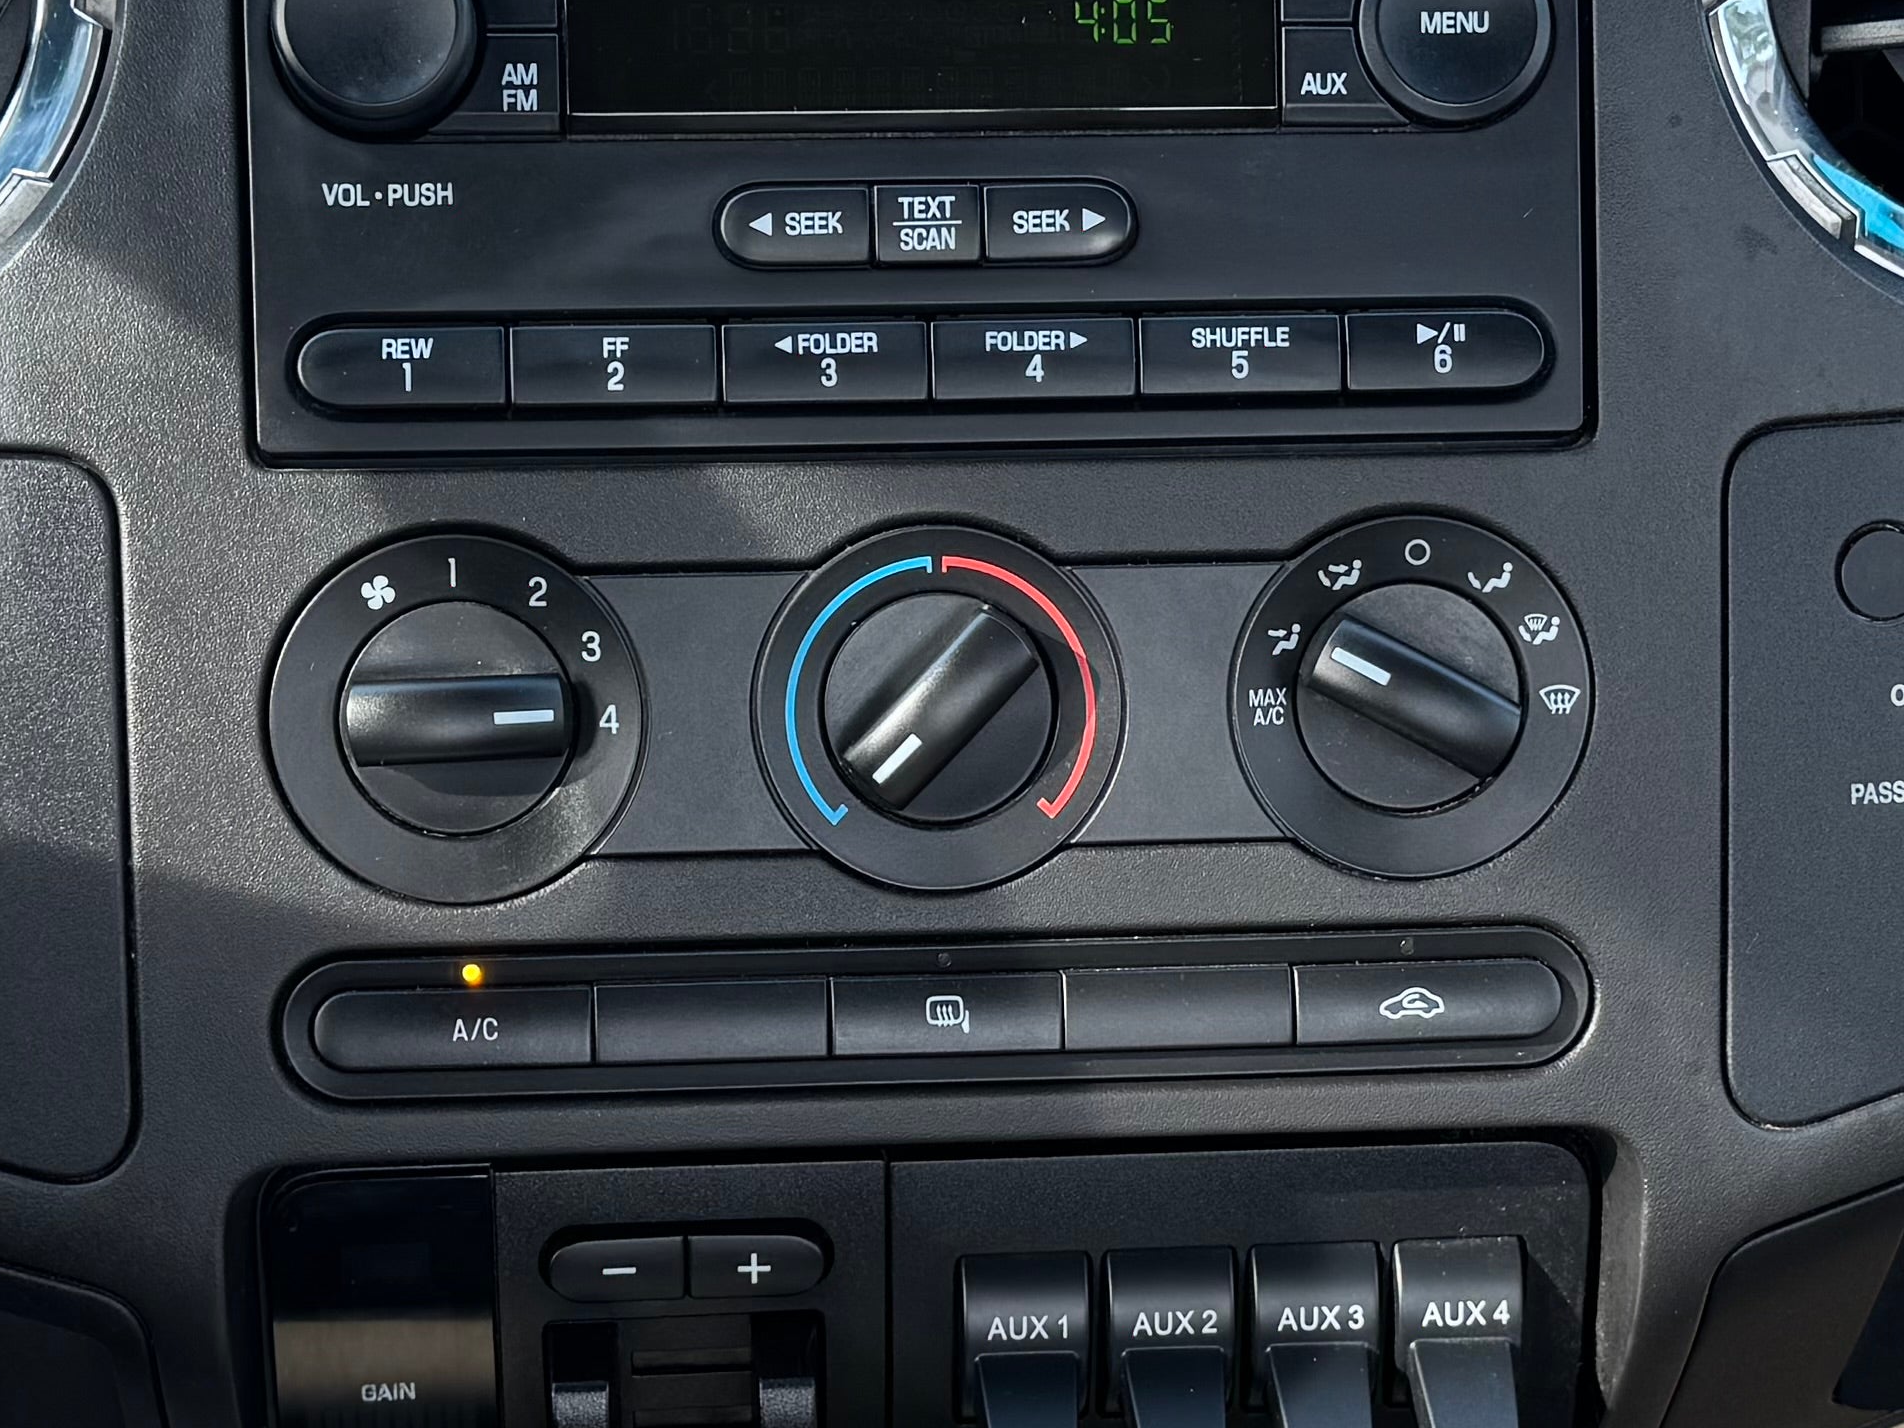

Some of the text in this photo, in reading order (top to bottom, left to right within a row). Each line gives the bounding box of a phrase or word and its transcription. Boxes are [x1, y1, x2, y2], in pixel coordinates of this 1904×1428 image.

[1420, 10, 1490, 35] MENU
[501, 62, 538, 86] AM
[1300, 72, 1348, 95] AUX
[502, 88, 538, 112] FM
[321, 182, 454, 207] VOL PUSH
[898, 196, 955, 219] TEXT
[784, 211, 843, 236] SEEK
[1012, 208, 1071, 234] SEEK
[899, 226, 956, 251] SCAN
[381, 337, 434, 360] REW
[602, 336, 630, 359] FF
[797, 331, 879, 355] FOLDER
[985, 330, 1066, 352] FOLDER
[1191, 326, 1290, 349] SHUFFLE
[1025, 353, 1045, 383] 4
[1231, 350, 1249, 380] 5
[1434, 344, 1453, 374] 6
[402, 362, 412, 392] 1
[607, 360, 625, 391] 2
[820, 357, 838, 388] 3
[447, 557, 457, 588] 1
[528, 576, 548, 607] 2
[581, 630, 602, 662] 3
[1248, 687, 1287, 708] MAX
[599, 704, 620, 735] 4
[1253, 705, 1284, 727] A/C
[452, 1017, 499, 1042] A/C
[1132, 1309, 1218, 1337] AUX 2
[1277, 1304, 1365, 1332] AUX 3
[1421, 1299, 1511, 1327] AUX 4
[987, 1313, 1068, 1341] AUX 1
[361, 1383, 416, 1401] GAIN
